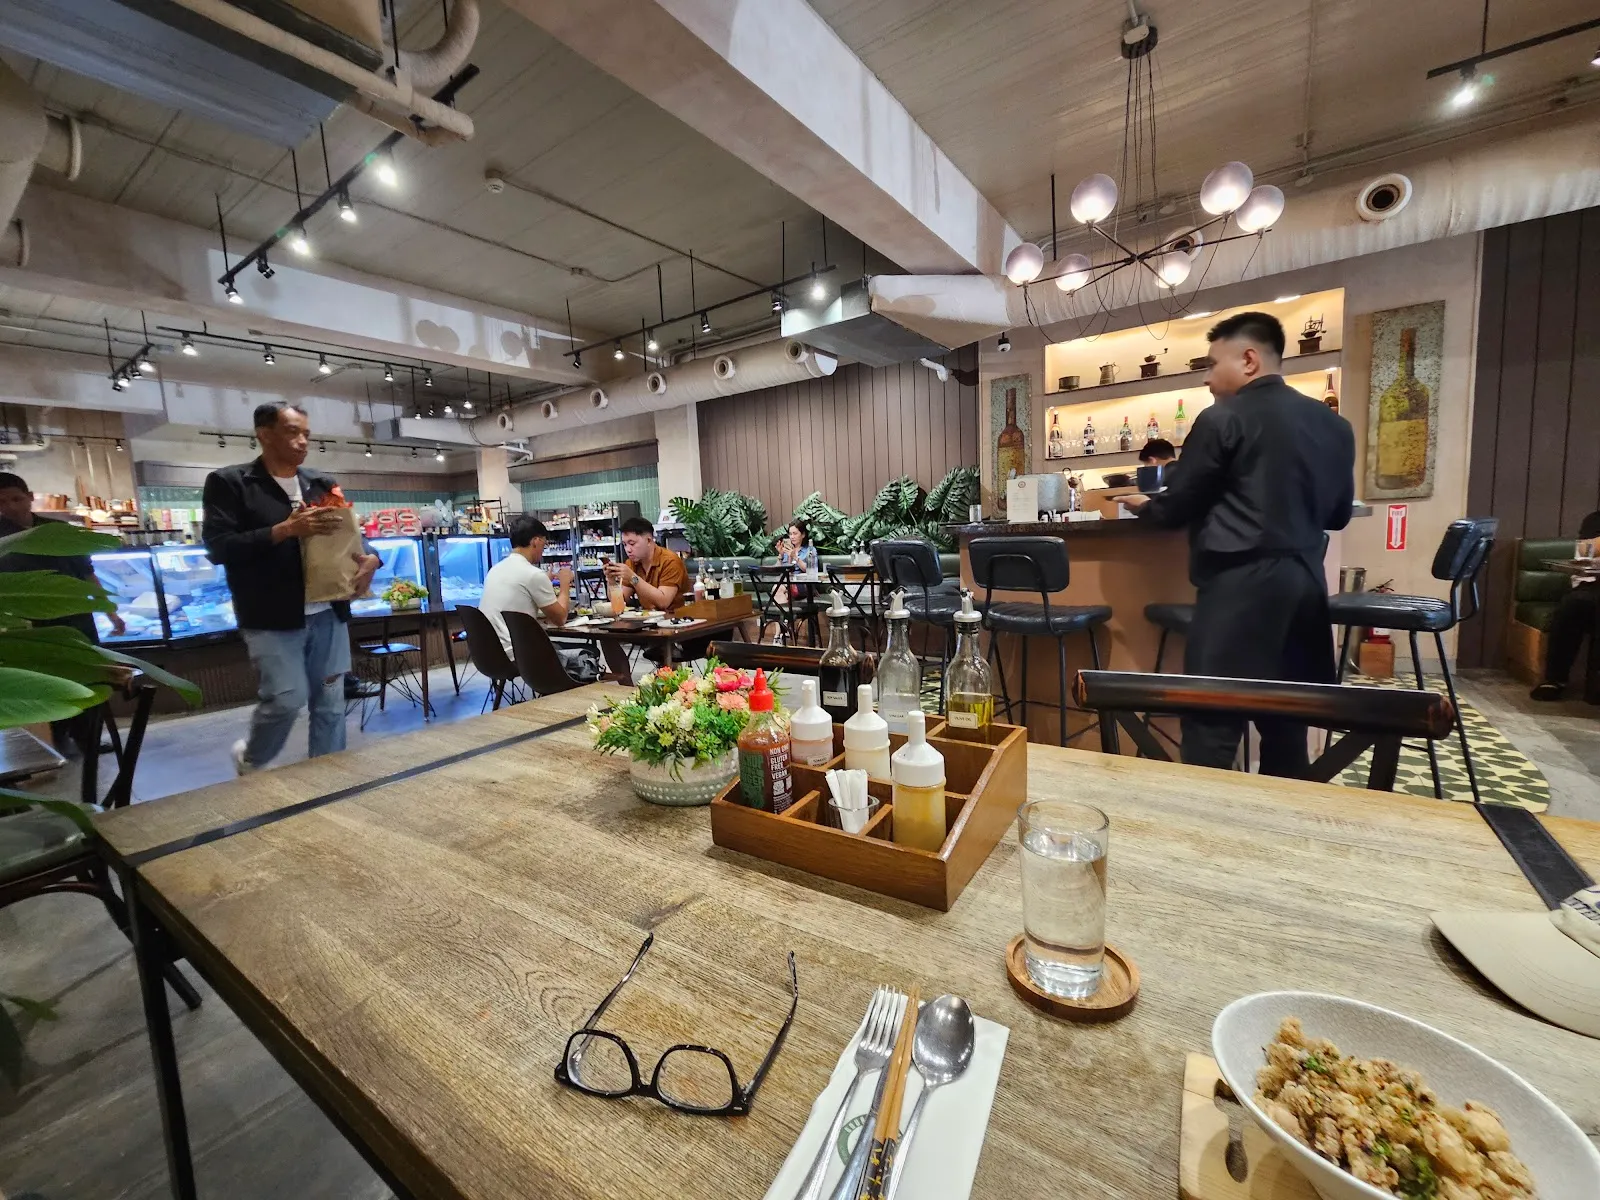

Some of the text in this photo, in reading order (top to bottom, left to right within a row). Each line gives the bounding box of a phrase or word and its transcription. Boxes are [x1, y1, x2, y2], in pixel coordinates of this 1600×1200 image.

[770, 747, 781, 755] NON
[770, 754, 788, 765] GLUTEN
[771, 762, 784, 772] FREE
[772, 769, 788, 780] VEGAN
